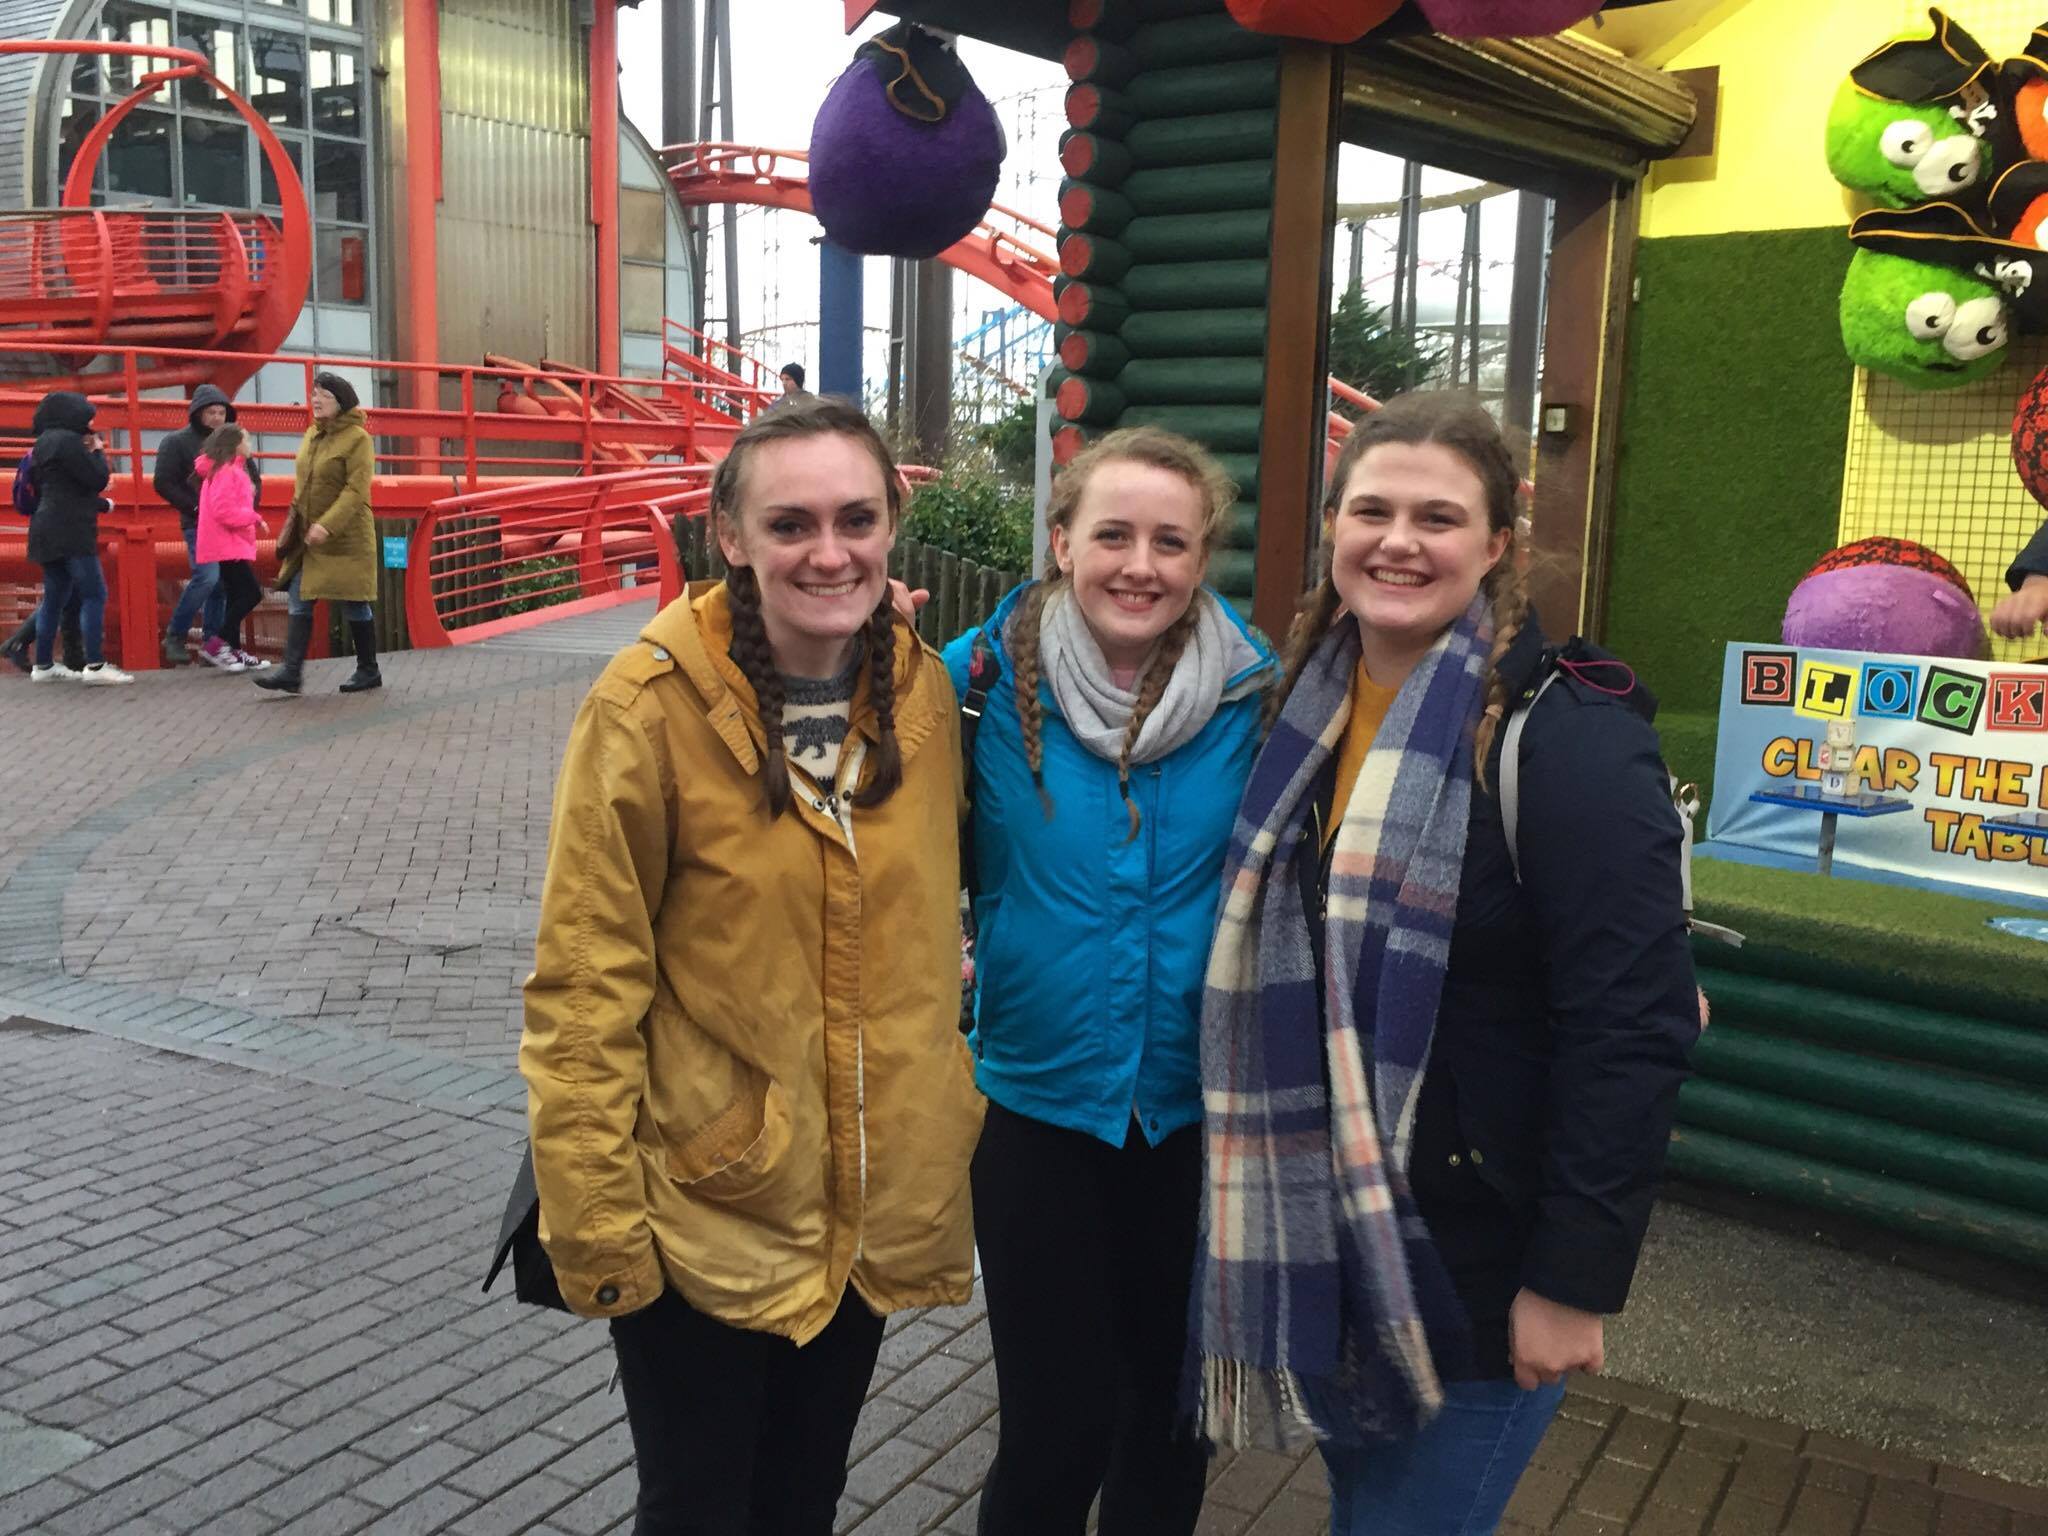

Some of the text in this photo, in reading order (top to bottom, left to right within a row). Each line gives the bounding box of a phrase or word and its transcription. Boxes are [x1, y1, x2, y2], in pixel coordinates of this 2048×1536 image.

[1750, 660, 2043, 725] BLOCK
[1762, 736, 1920, 793] CLAR
[1930, 751, 2034, 808] THE
